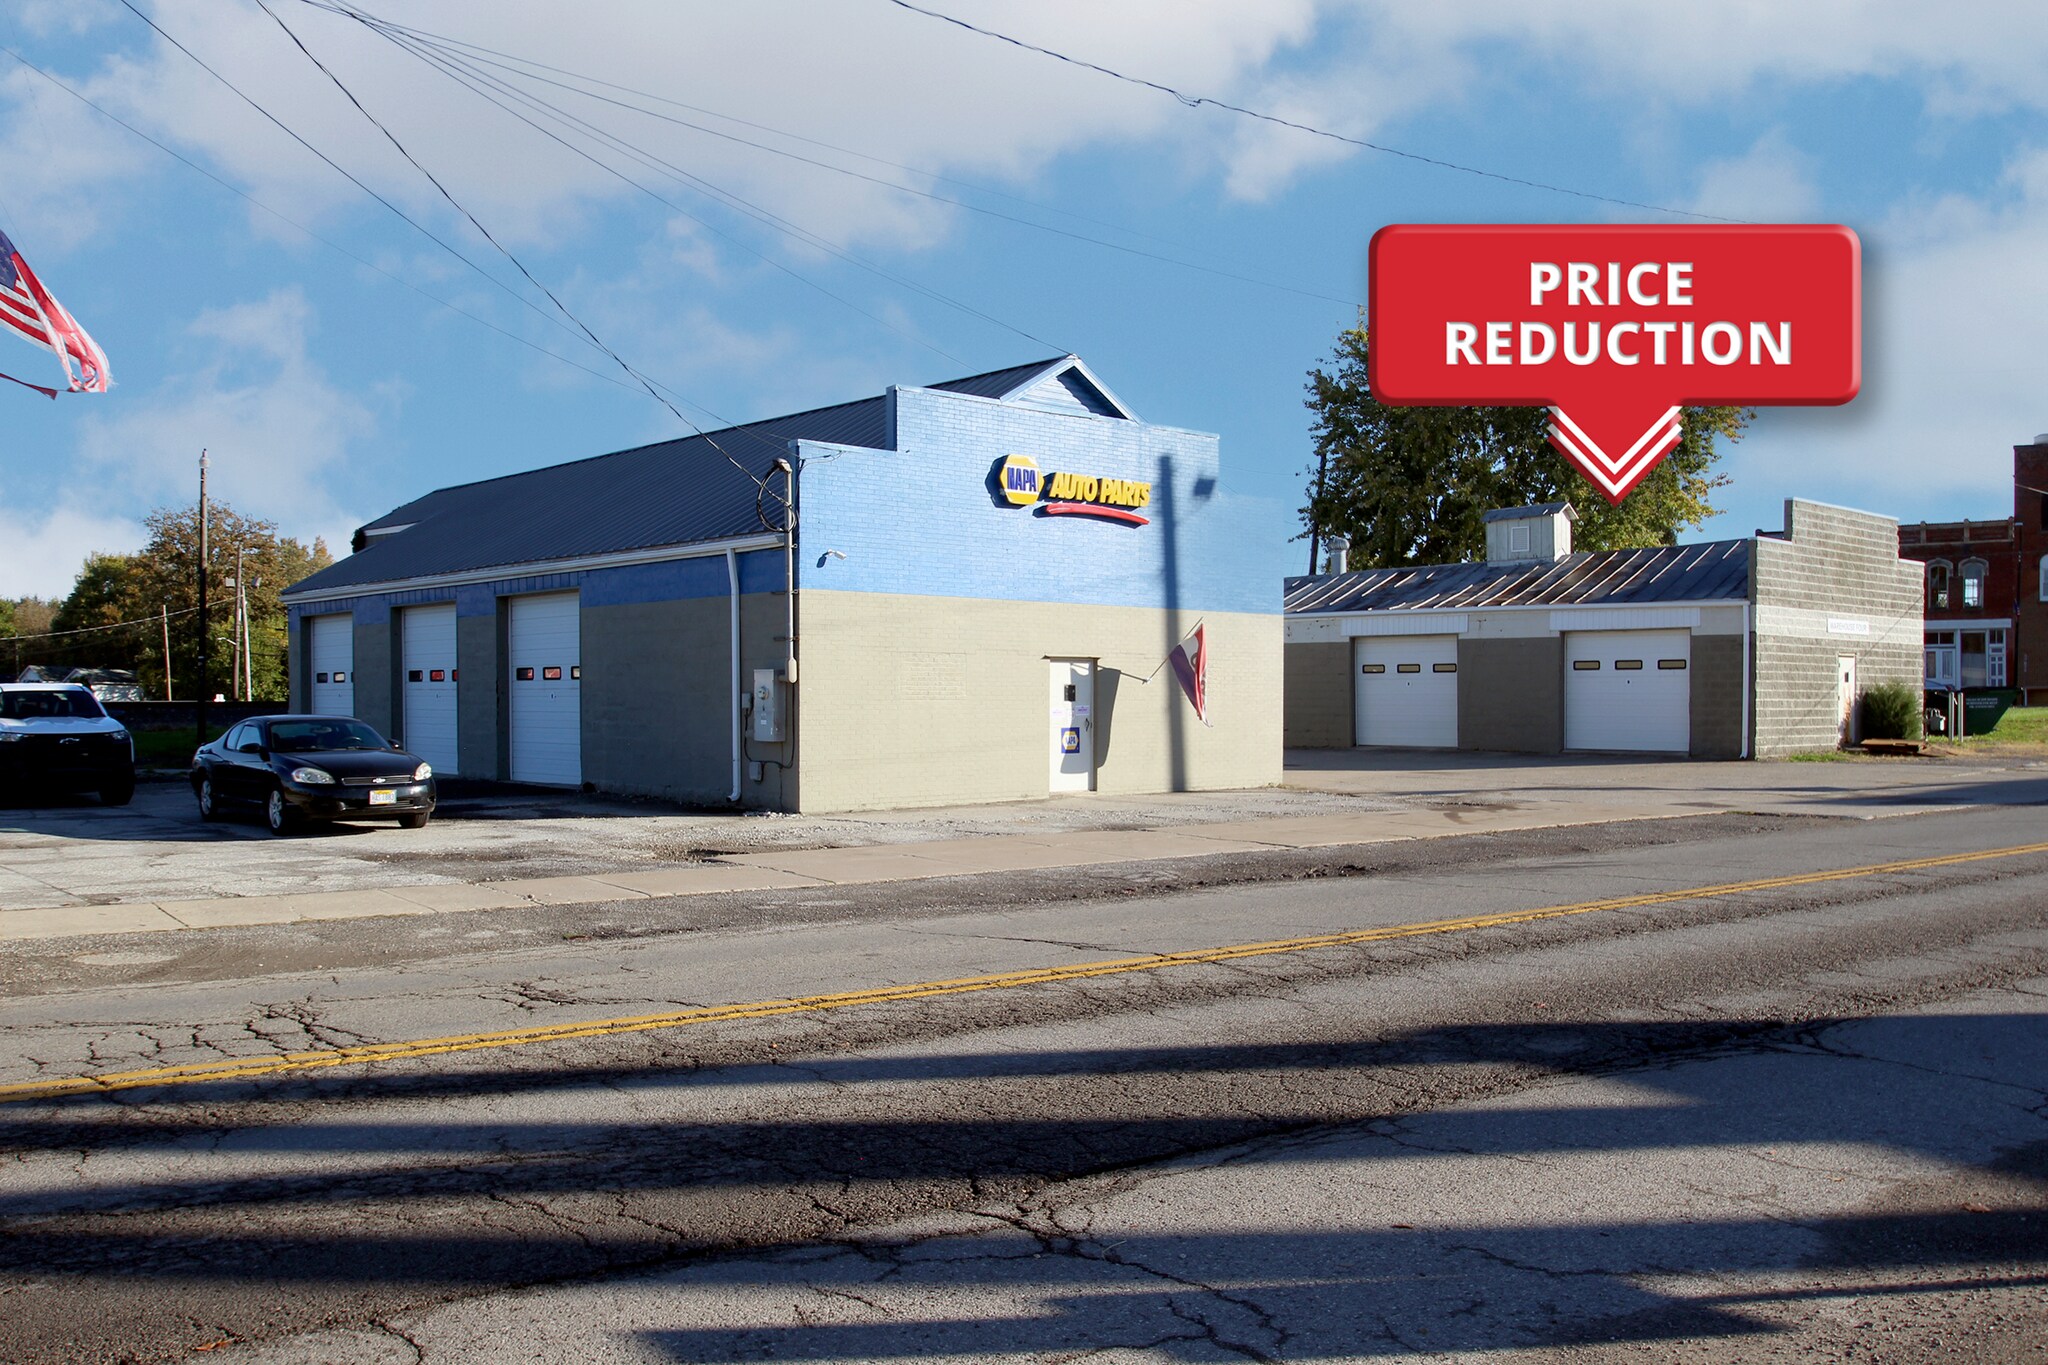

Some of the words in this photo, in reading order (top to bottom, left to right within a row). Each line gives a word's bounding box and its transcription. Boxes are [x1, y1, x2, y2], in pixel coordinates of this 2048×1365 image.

[1007, 466, 1037, 492] NAPA
[1049, 472, 1098, 502] AUTO
[1100, 478, 1152, 507] PARTS
[1829, 621, 1855, 632] WAREHOUSE
[1855, 623, 1867, 633] FOUR
